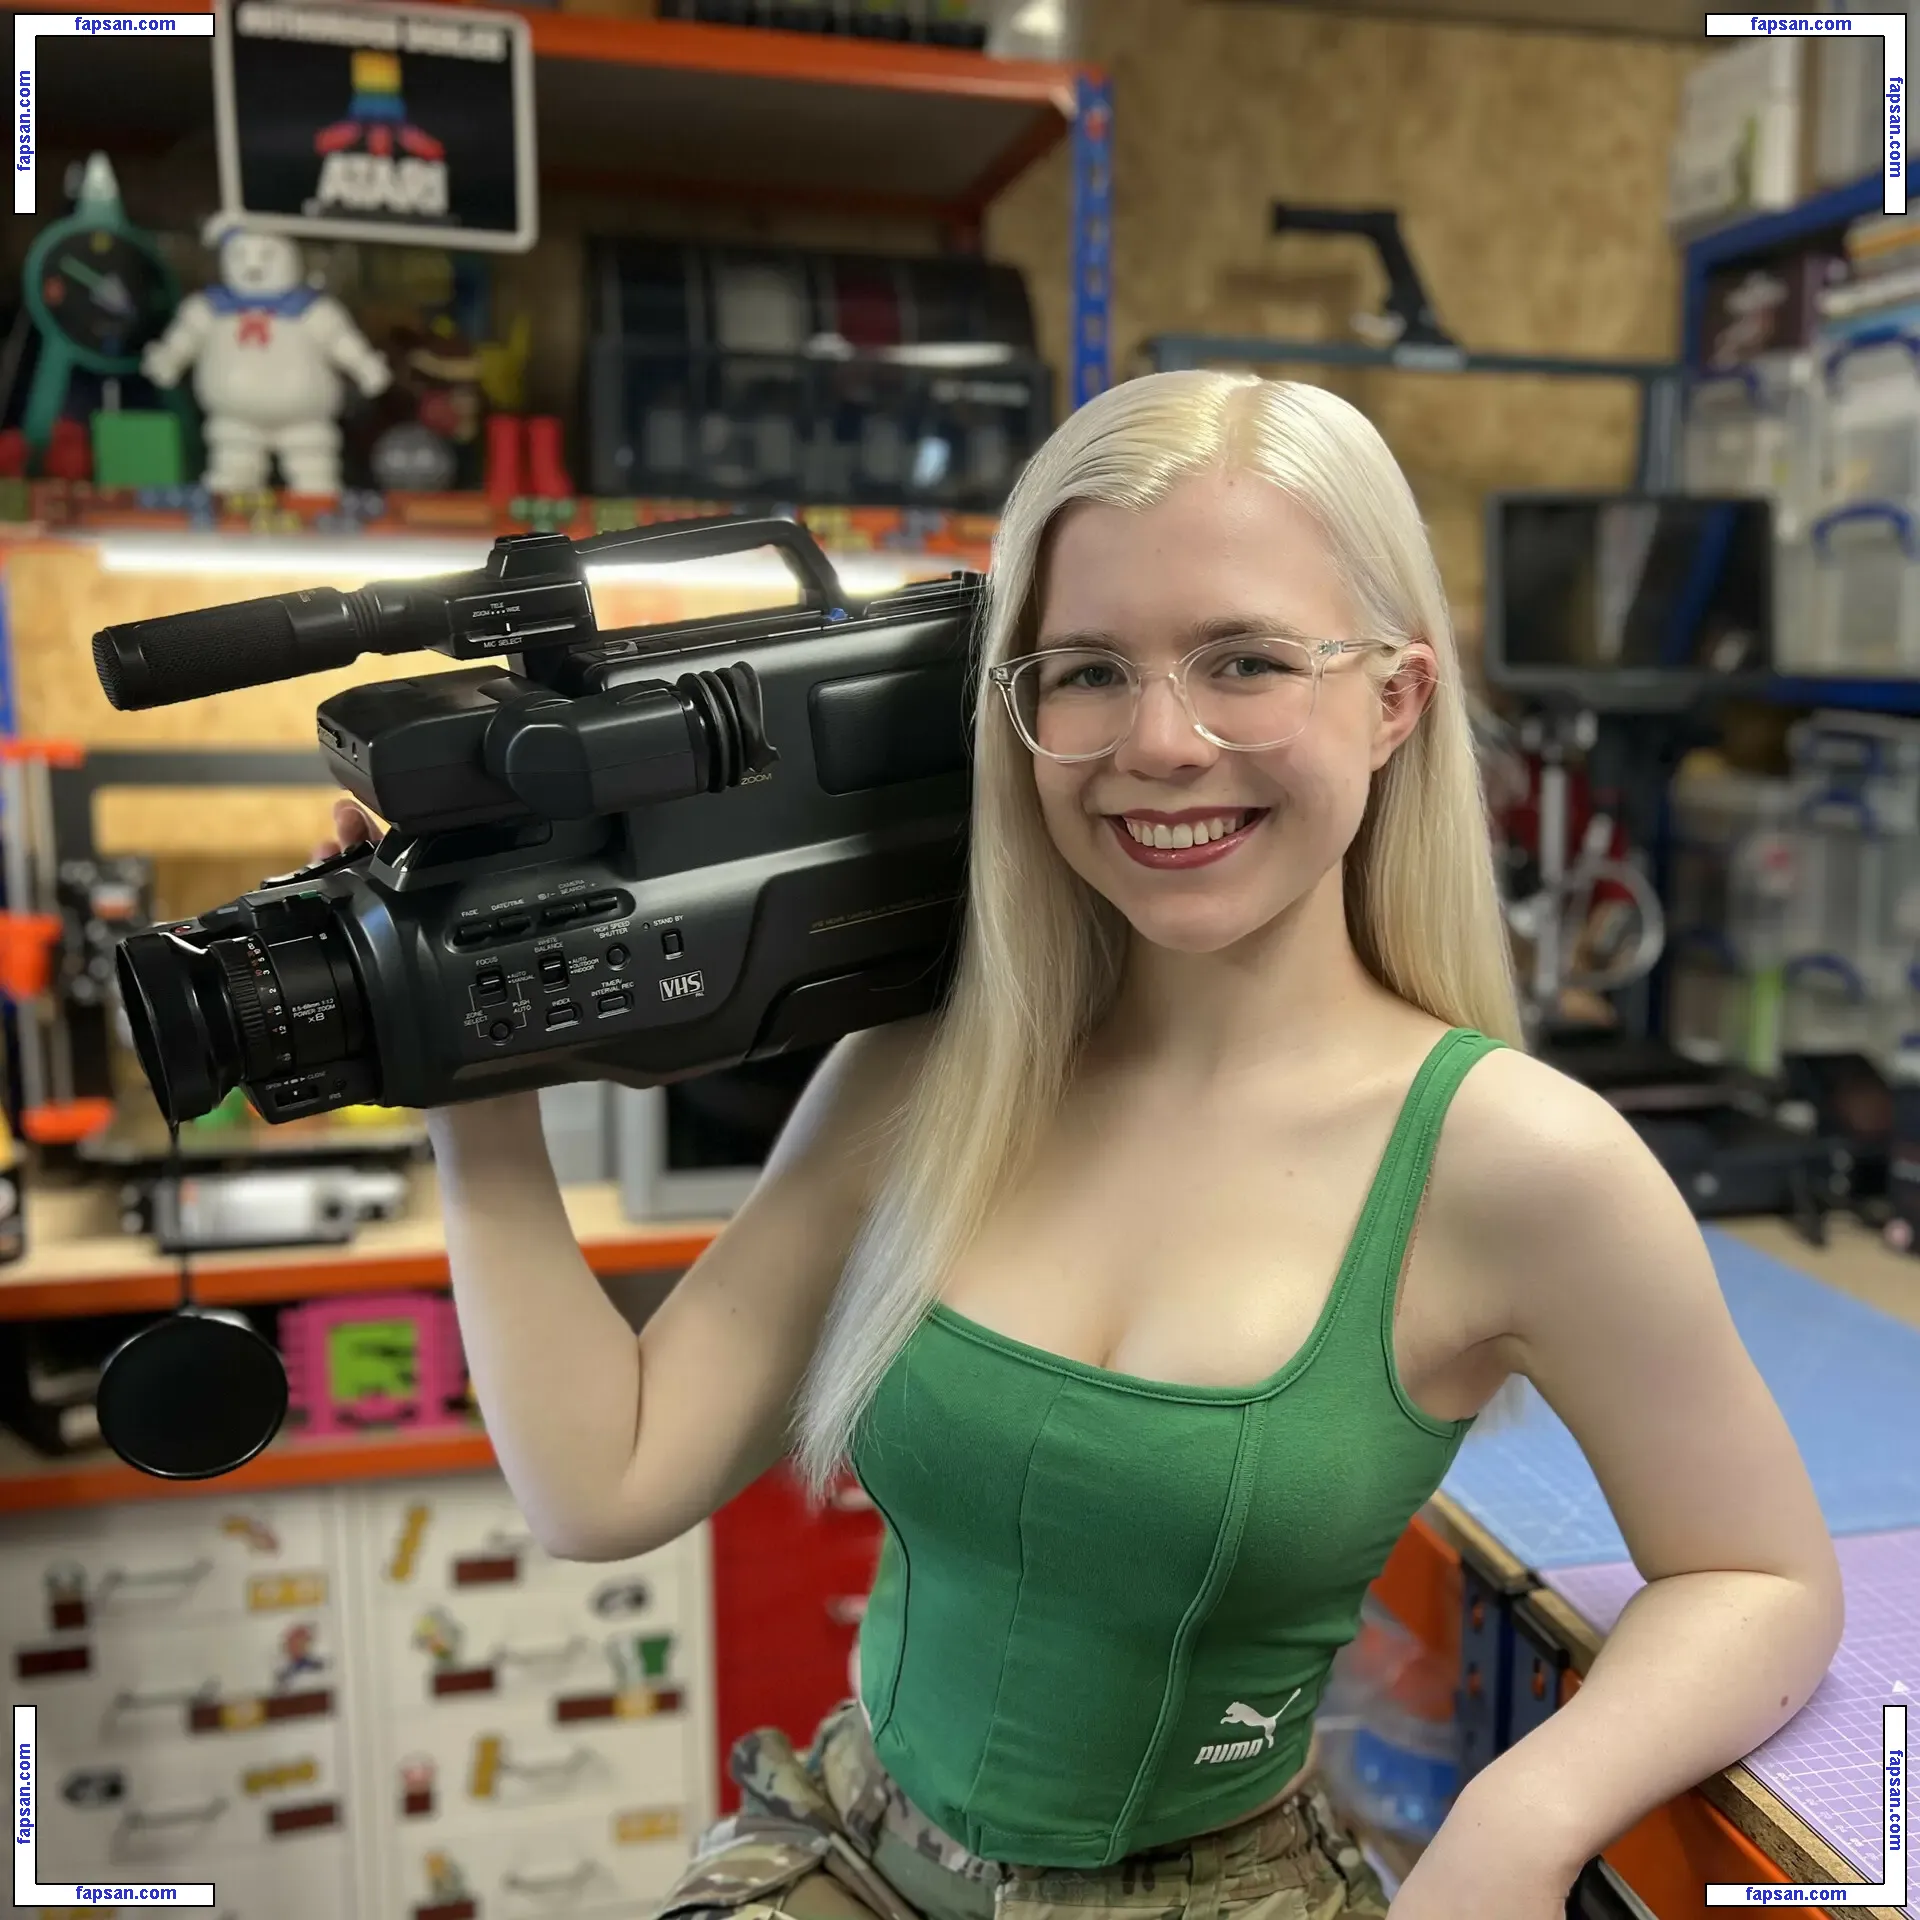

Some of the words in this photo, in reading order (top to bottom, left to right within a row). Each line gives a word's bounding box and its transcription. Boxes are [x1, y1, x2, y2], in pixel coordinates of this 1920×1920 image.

[498, 637, 522, 646] SELECT
[740, 771, 772, 786] ZOOM
[560, 884, 586, 895] SEARCH
[491, 899, 525, 910] DATE/TIME
[461, 909, 479, 917] FADE
[653, 918, 673, 926] STAND
[674, 915, 684, 923] BY
[593, 924, 612, 934] HIGH
[612, 921, 630, 930] SPEED
[599, 927, 628, 938] SHUTTER
[534, 942, 564, 953] BALANCE
[476, 956, 498, 966] FOCUS
[572, 956, 588, 964] AUTO
[572, 958, 600, 969] OUTDOOR
[511, 970, 526, 978] AUTO
[591, 986, 620, 997] INTERVAL
[621, 981, 634, 990] REC
[662, 973, 701, 998] VHS
[512, 1000, 530, 1008] PUSH
[552, 998, 571, 1007] INDEX
[293, 1008, 316, 1018] POWER
[316, 1004, 336, 1013] ZOOM
[513, 1004, 532, 1014] AUTO
[464, 1014, 488, 1026] SELECT
[465, 1010, 484, 1020] ZONE
[1194, 1738, 1264, 1764] PUMA
